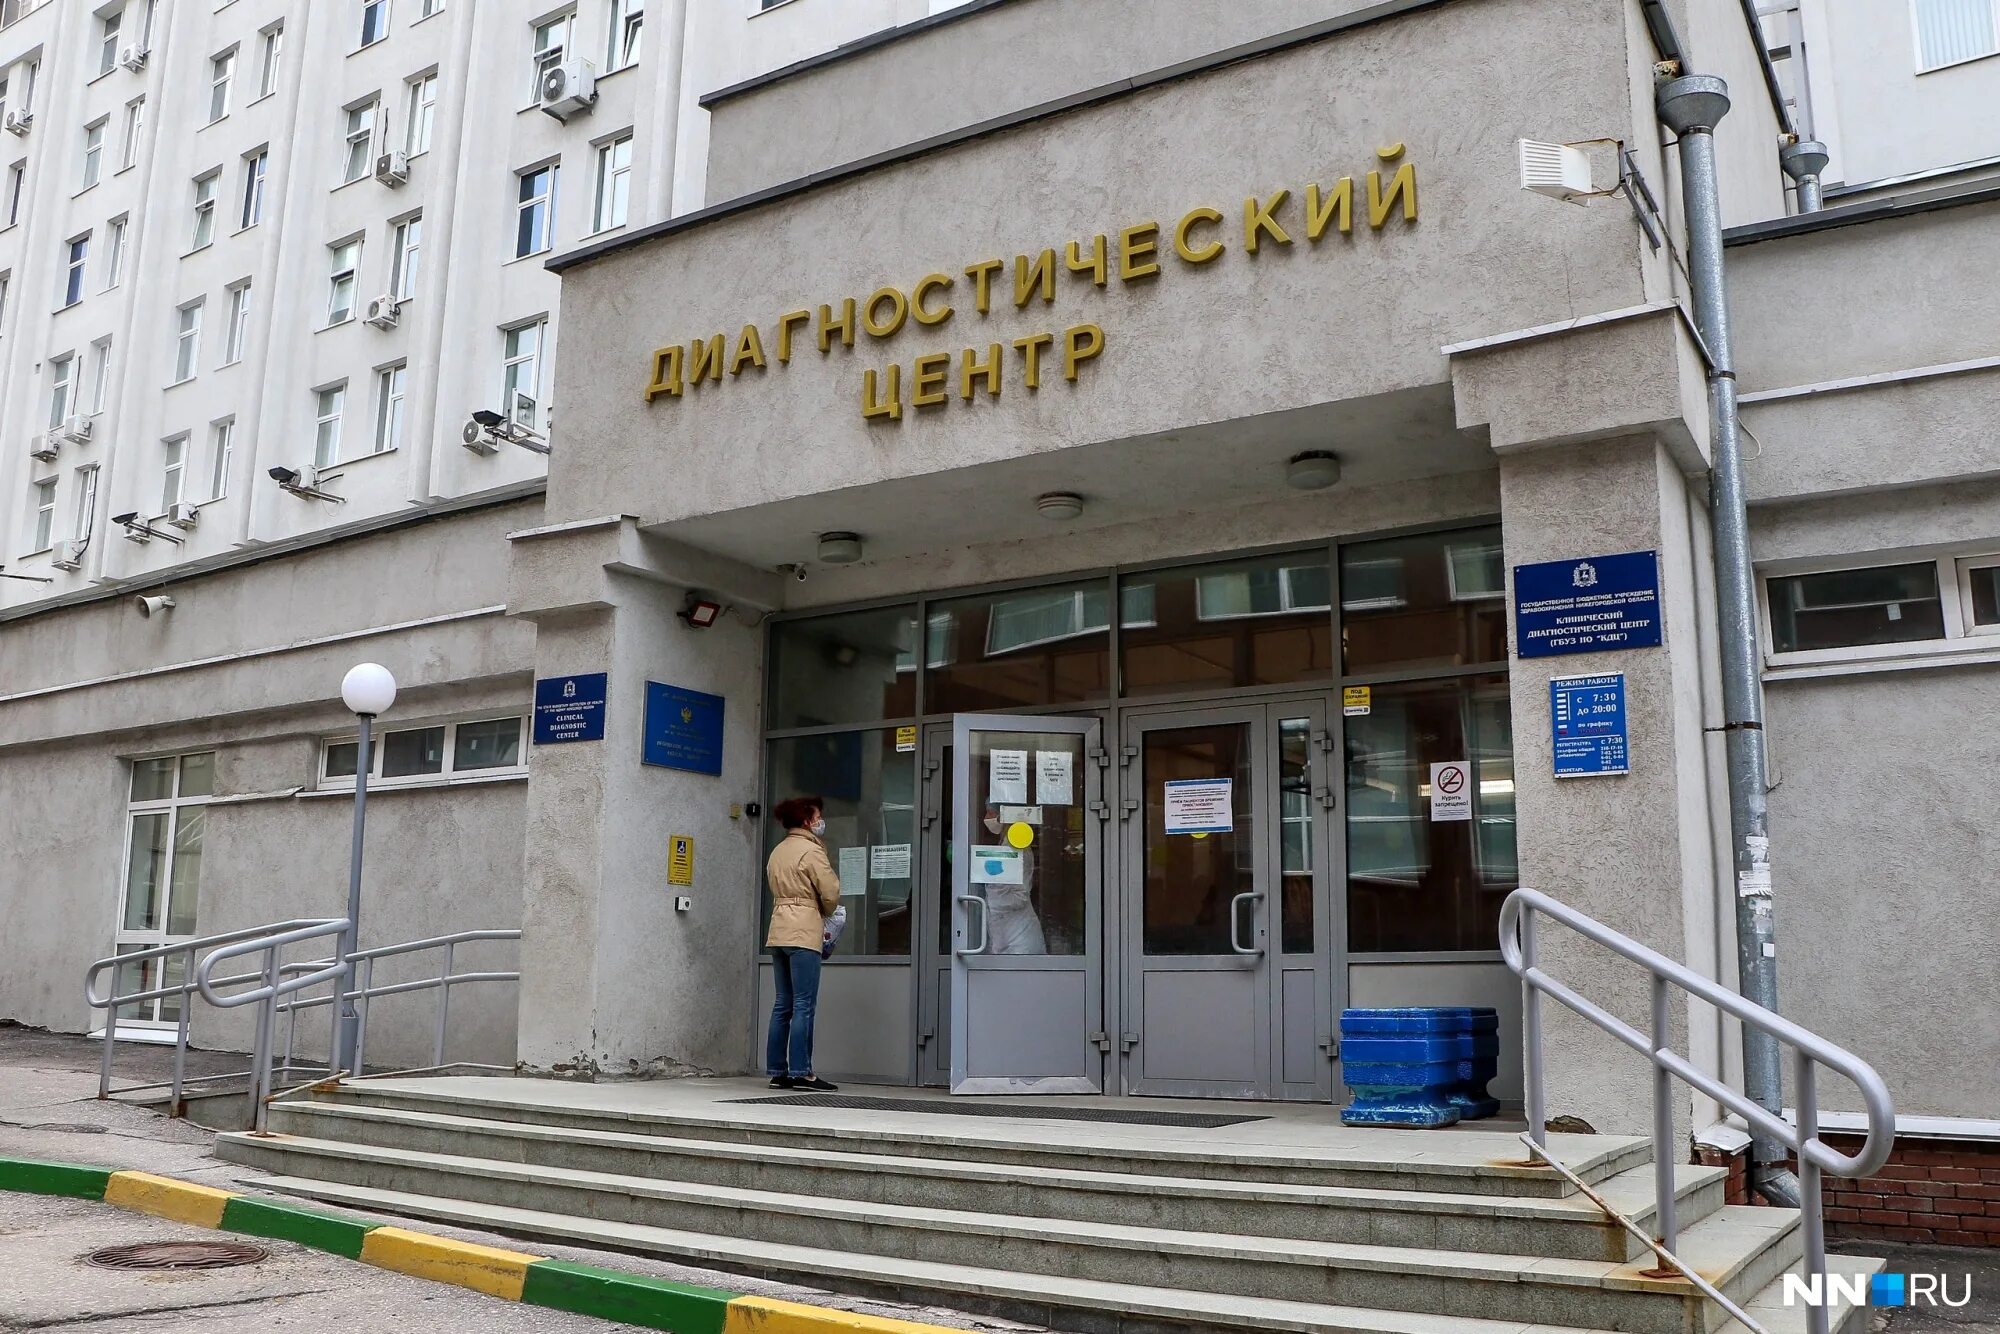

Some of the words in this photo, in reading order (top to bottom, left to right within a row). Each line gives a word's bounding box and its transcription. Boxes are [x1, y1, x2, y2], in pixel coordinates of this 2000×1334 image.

[644, 142, 1418, 401] ДИАГНОСТИЧЕСКИЙ
[861, 323, 1106, 421] ЦЕНТР
[1520, 597, 1575, 608] ГОСУДАРСТВЕННОЕ
[1576, 593, 1613, 603] БЮДЖЕТНОЕ
[1614, 590, 1654, 598] УЧРЕЖДЕНИЕ
[1520, 603, 1574, 614] ЗДРАВООХРАНЕНИЯ
[1575, 598, 1626, 608] НИЖЕГОРОДСКОЙ
[1628, 595, 1655, 603] ОБЛАСТИ
[1556, 611, 1623, 625] КЛИНИЧЕСКИЙ
[1527, 621, 1617, 639] ДИАГНОСТИЧЕСКИЙ
[1620, 619, 1650, 630] ЦЕНТР
[1550, 636, 1576, 647] (ГБУЗ
[1580, 635, 1593, 644] НО
[1596, 632, 1628, 643] "КДЦ")
[1556, 680, 1585, 688] РЕЖИМ
[1587, 677, 1618, 686] РАБОТЫ
[1593, 693, 1616, 702] 7:30
[1592, 704, 1617, 713] 20:00
[556, 713, 584, 722] CLINICAL
[550, 722, 587, 731] DIAGNOSTIC
[556, 731, 579, 739] CENTER
[1434, 800, 1469, 808] запрещено!
[1441, 795, 1461, 803] Курить
